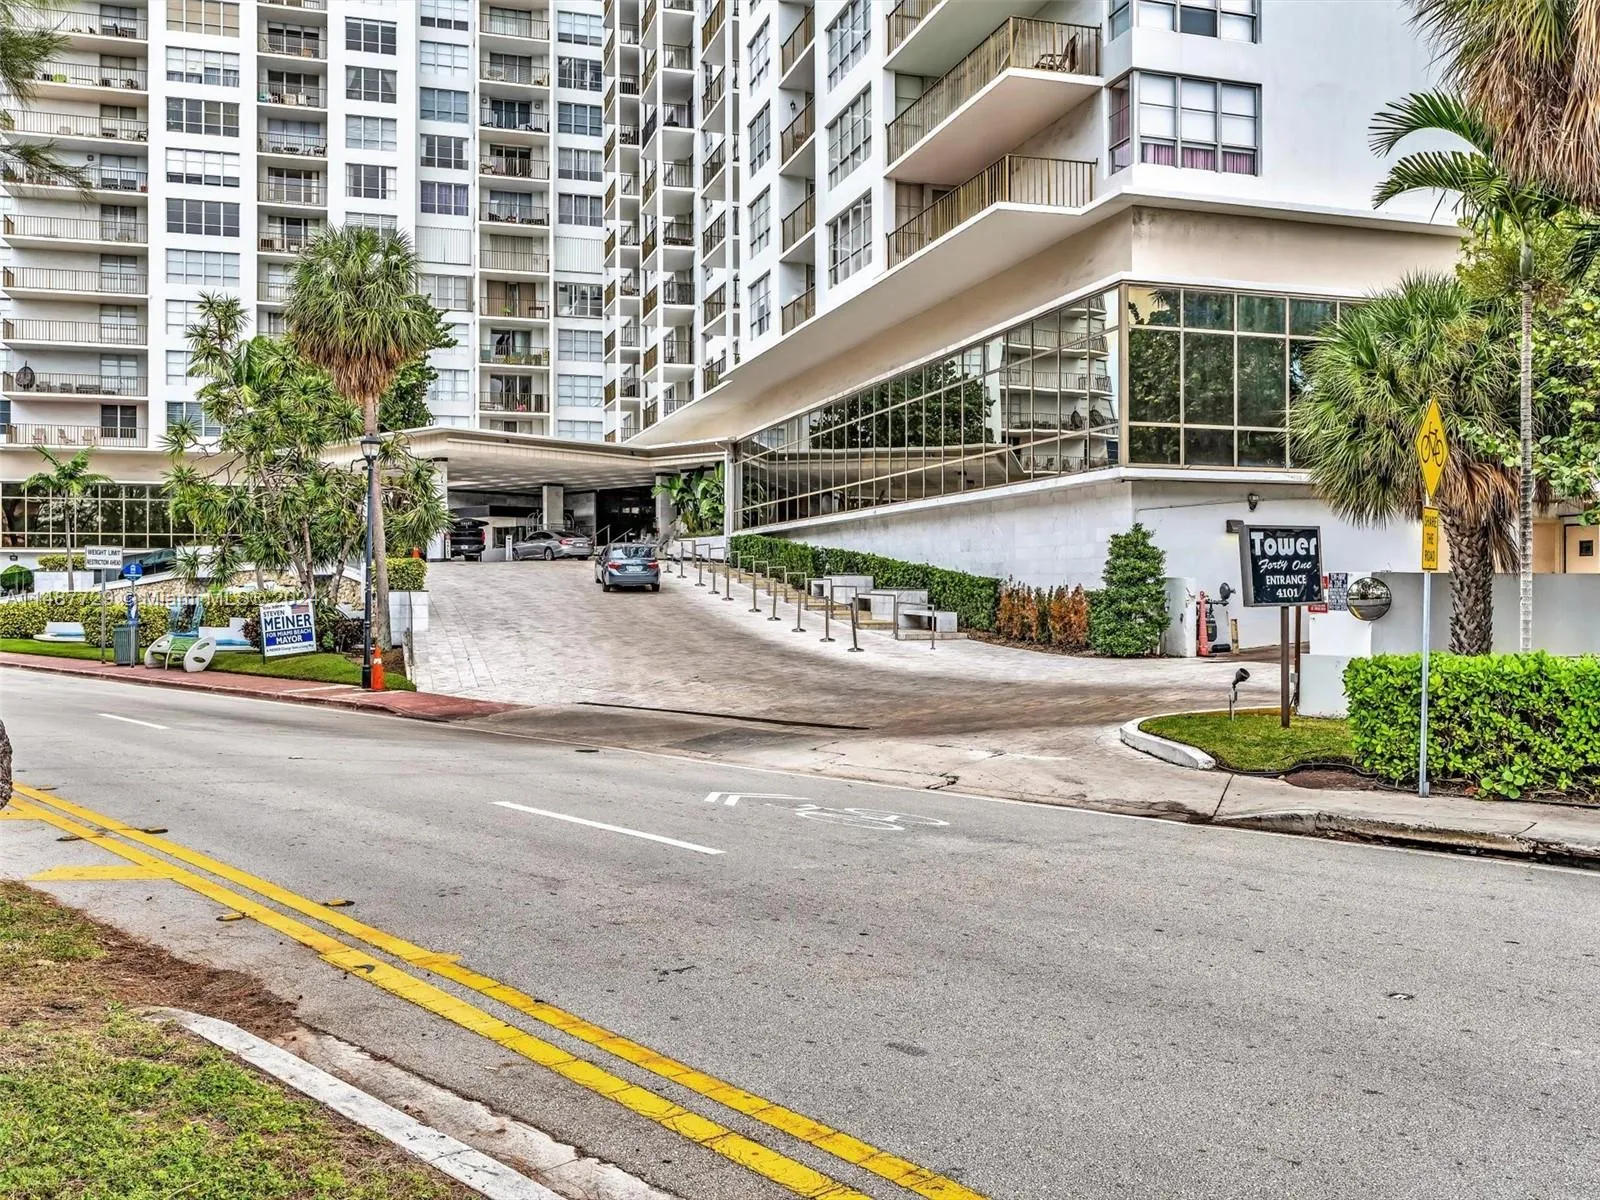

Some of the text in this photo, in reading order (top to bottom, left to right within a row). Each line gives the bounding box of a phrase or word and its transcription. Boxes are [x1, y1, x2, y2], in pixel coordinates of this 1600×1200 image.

[1425, 515, 1437, 528] SHARE
[1250, 532, 1317, 556] Tower
[1425, 550, 1435, 562] ROAD
[1258, 559, 1312, 573] Forty One
[1266, 575, 1307, 585] ENTRANCE
[1276, 588, 1299, 598] 4101
[263, 614, 312, 631] MEINER
[266, 631, 277, 639] FOR
[276, 634, 303, 645] MAYOR
